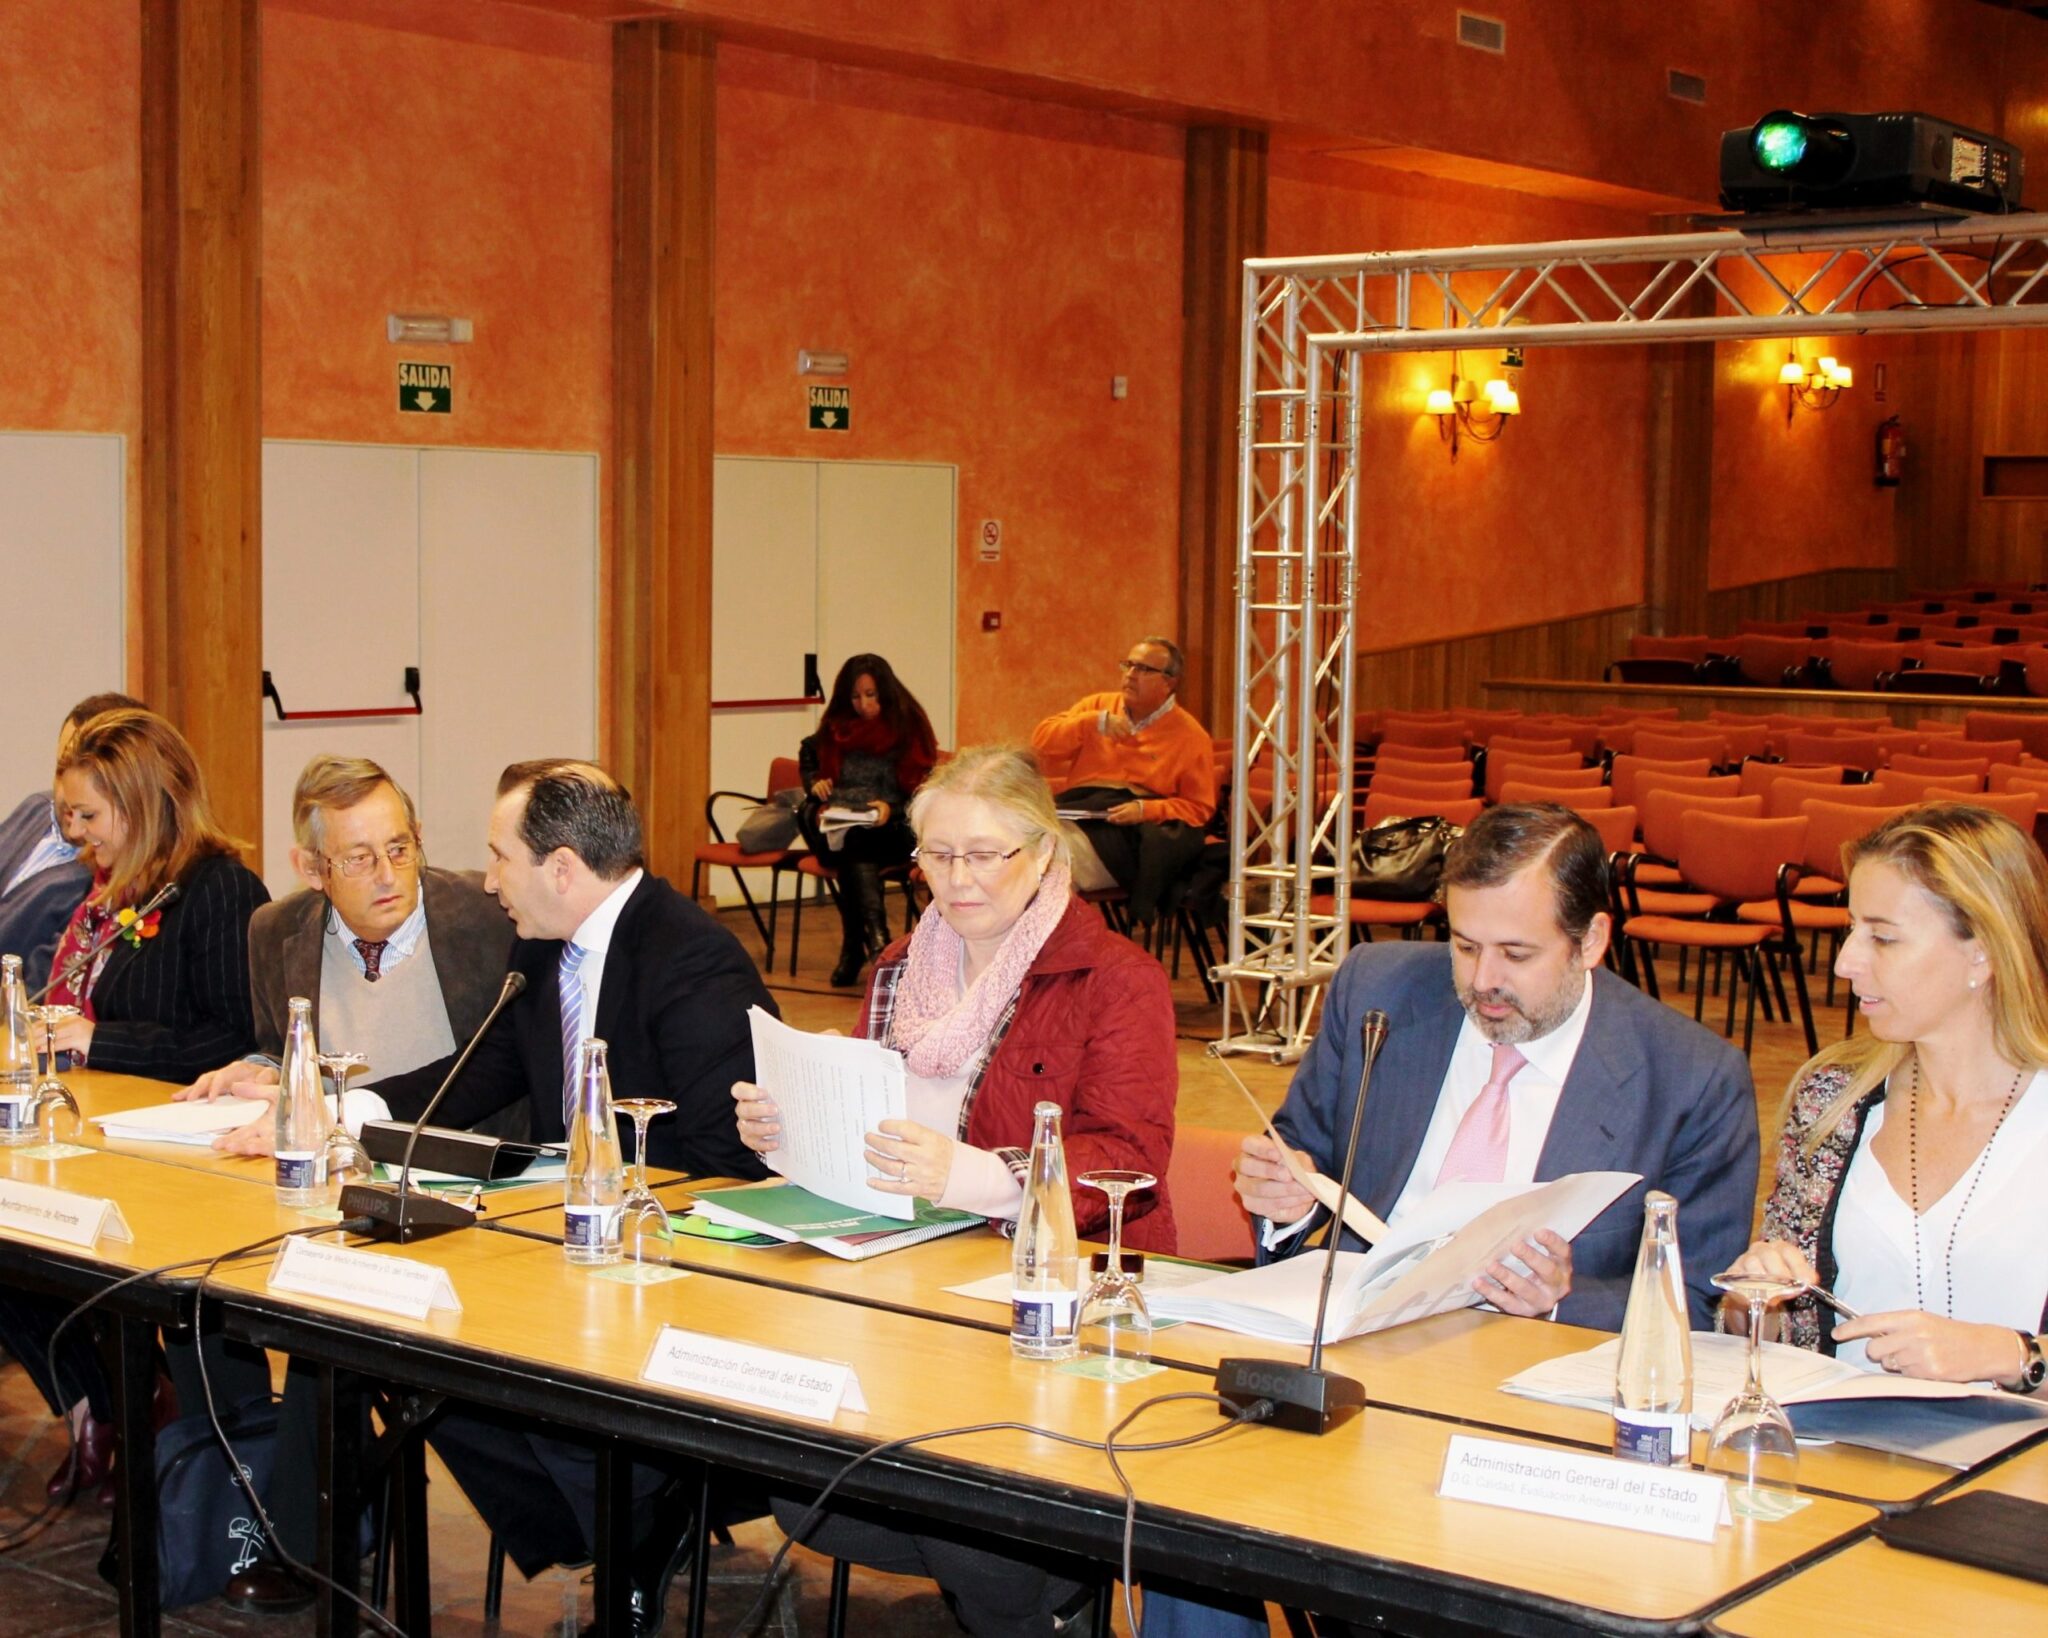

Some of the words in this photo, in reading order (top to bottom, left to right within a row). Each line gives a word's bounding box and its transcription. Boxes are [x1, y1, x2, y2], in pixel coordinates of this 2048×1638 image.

[400, 364, 450, 389] SALIDA
[810, 387, 849, 409] SALIDA
[346, 1192, 390, 1214] PHILIPS
[668, 1346, 738, 1373] Administración
[741, 1361, 779, 1382] General
[780, 1369, 797, 1385] del
[798, 1374, 833, 1394] Estado
[1236, 1367, 1299, 1396] BOSCH
[709, 1375, 719, 1386] de
[720, 1377, 746, 1392] Estado
[746, 1382, 758, 1394] de
[758, 1385, 780, 1399] Medio
[782, 1390, 819, 1407] Ambiente
[1460, 1452, 1561, 1481] Administración
[1565, 1468, 1619, 1490] General
[1623, 1479, 1645, 1495] del
[1649, 1482, 1698, 1504] Estado
[1578, 1493, 1632, 1512] Ambiental
[1661, 1507, 1701, 1524] Natural
